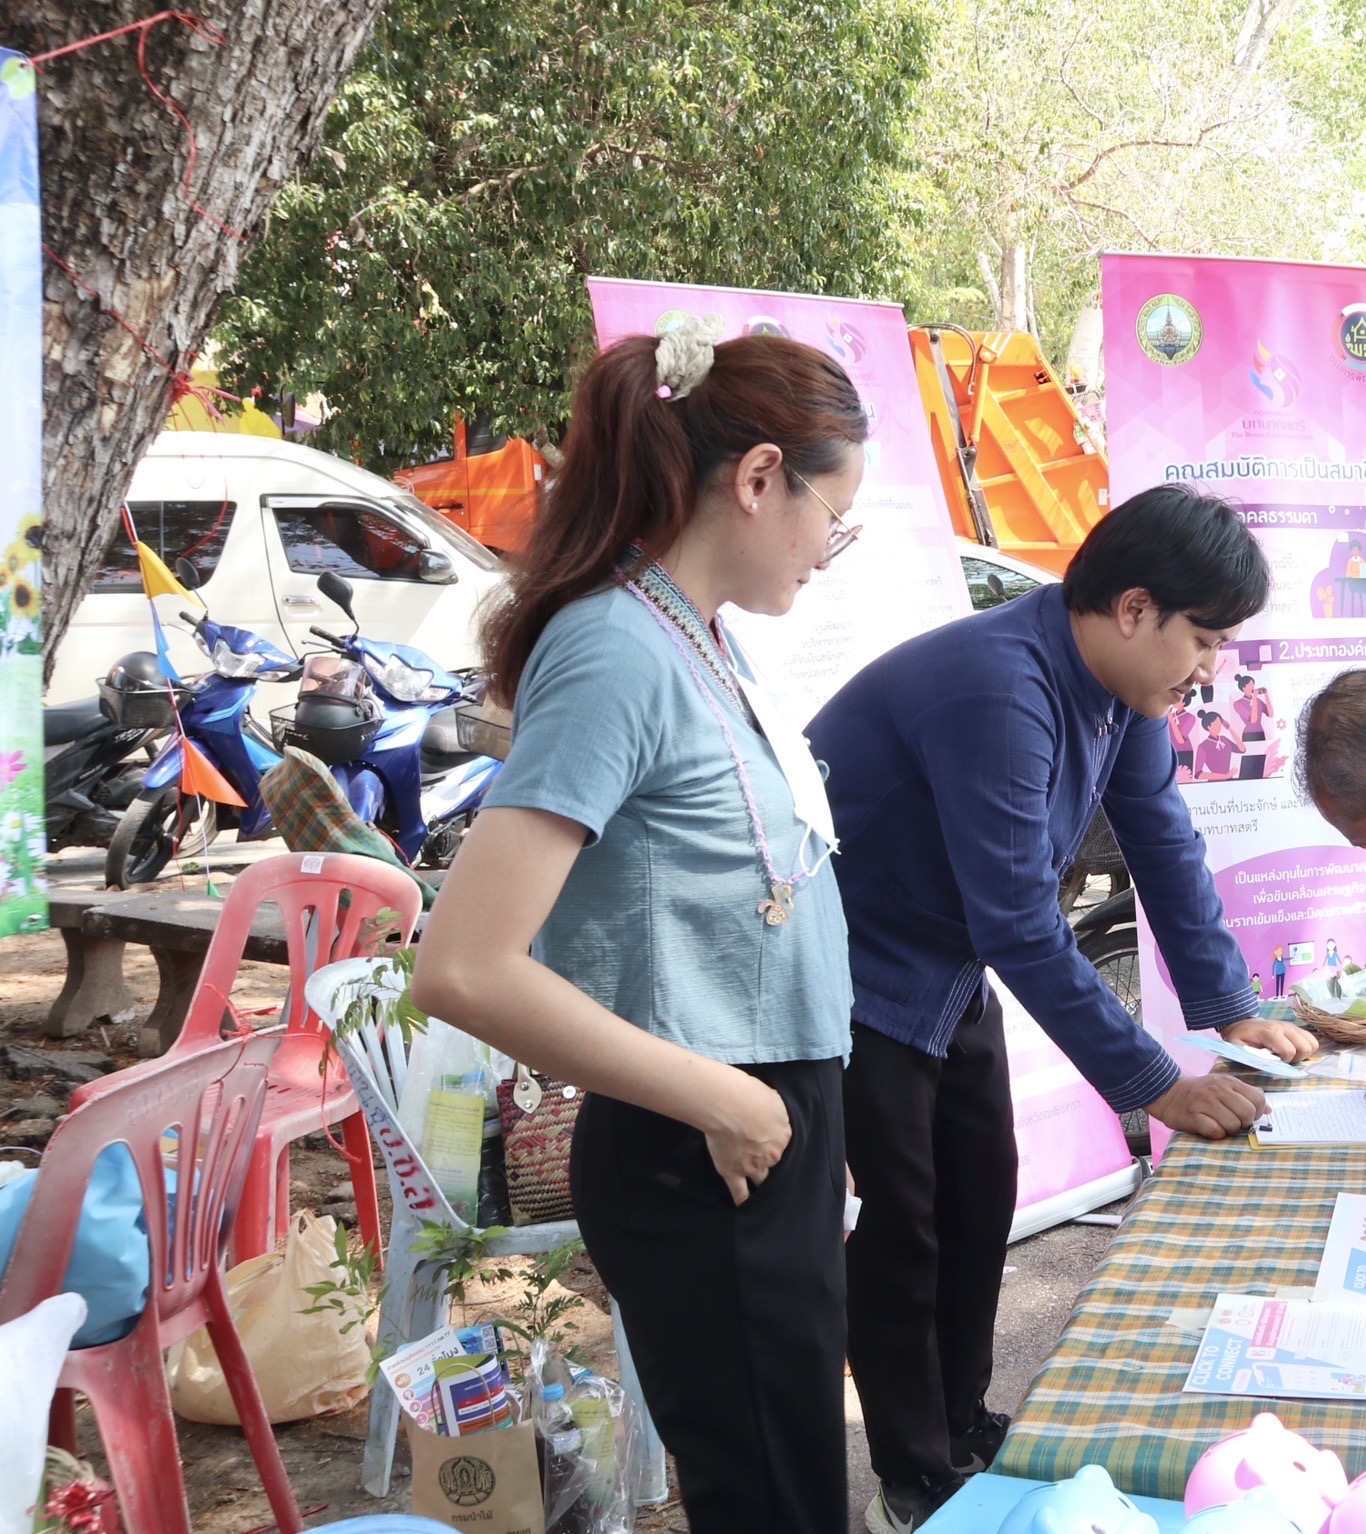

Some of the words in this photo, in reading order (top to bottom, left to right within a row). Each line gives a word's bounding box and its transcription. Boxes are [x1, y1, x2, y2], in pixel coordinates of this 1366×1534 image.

[1253, 881, 1366, 904] เพื่อขับเคลื่อนเศรษฐกิจ
[416, 1365, 431, 1376] 24
[431, 1347, 460, 1363] ั่วโมง
[1202, 1345, 1221, 1358] TO
[1215, 1337, 1244, 1380] CONNECT
[1191, 1358, 1217, 1385] CLICK
[451, 1510, 494, 1522] กรมป่าไม้
